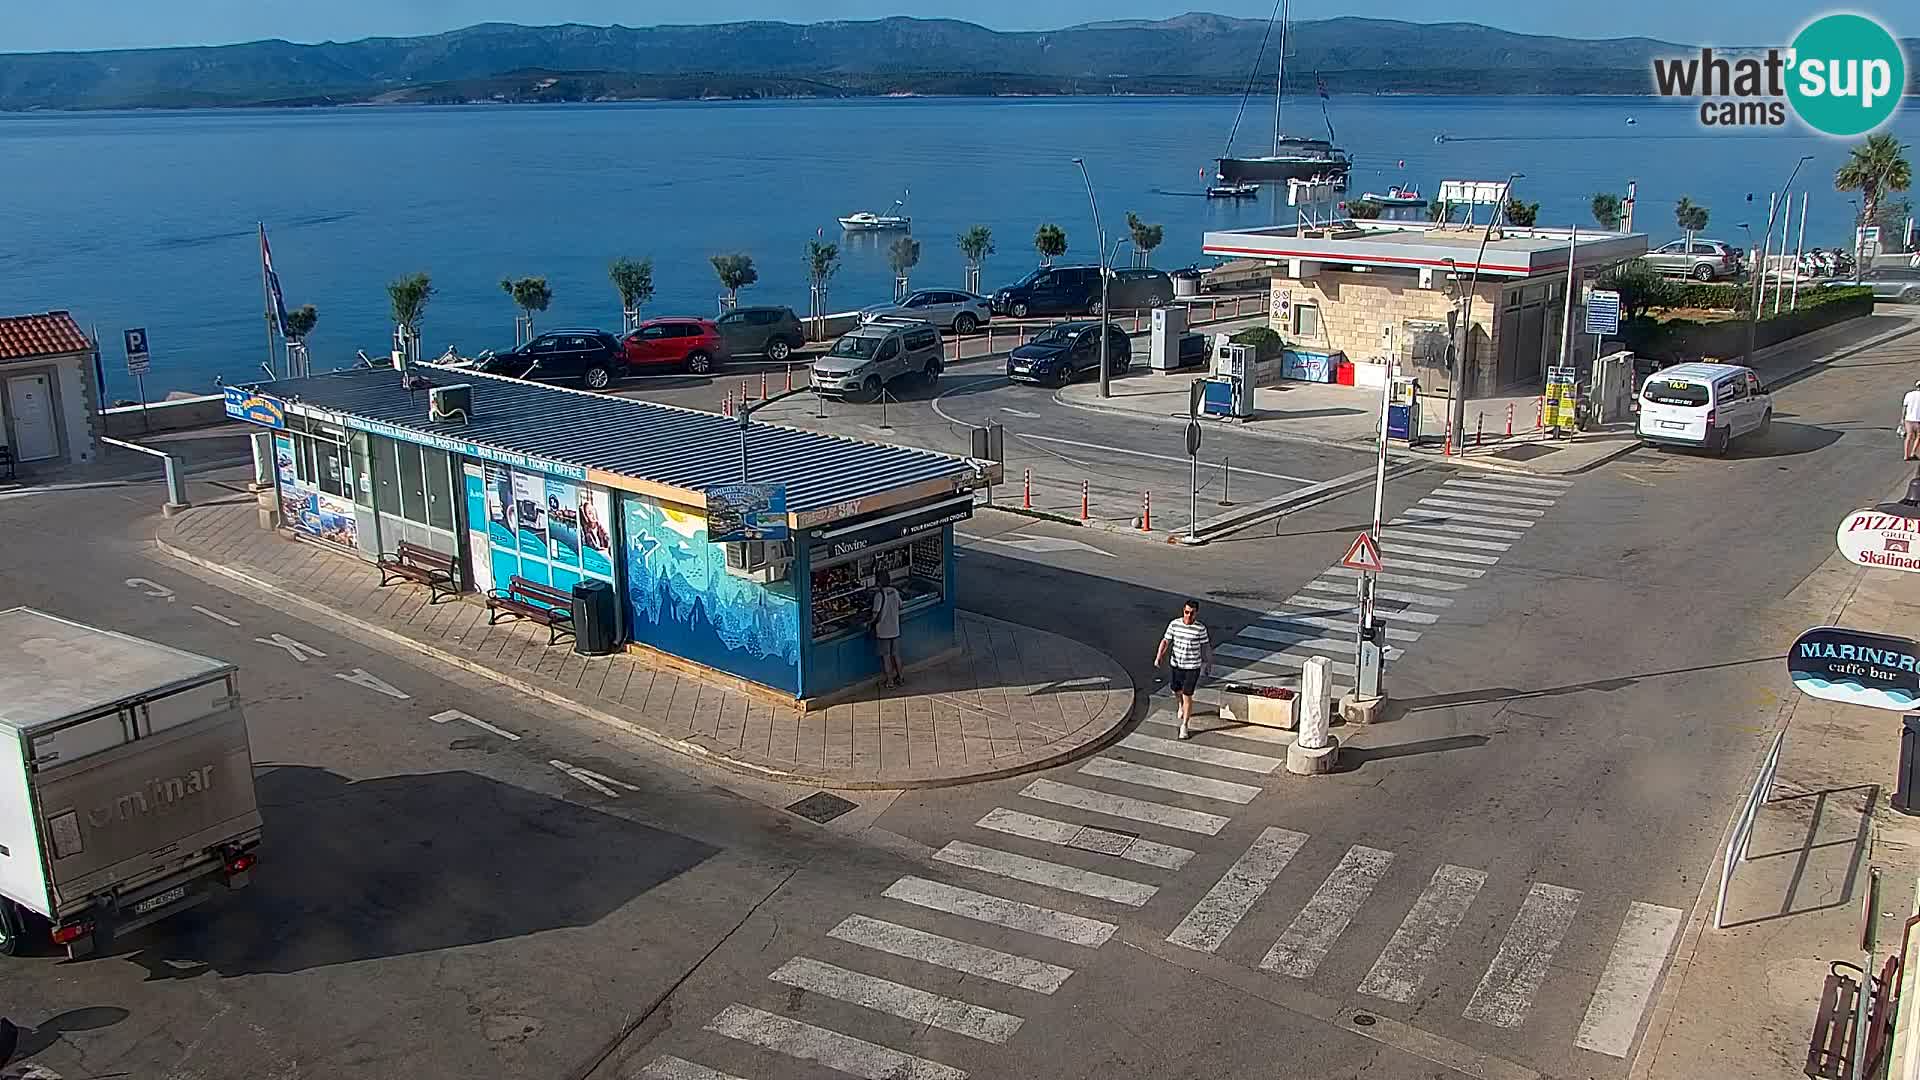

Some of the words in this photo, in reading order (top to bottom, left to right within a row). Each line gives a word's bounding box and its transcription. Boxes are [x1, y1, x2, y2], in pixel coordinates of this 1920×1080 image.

[130, 332, 141, 350] P
[1669, 381, 1688, 389] TAXI
[436, 436, 467, 451] POSTAJA
[477, 445, 492, 458] BUS
[493, 448, 526, 465] STATION
[528, 456, 554, 473] TICKET
[554, 462, 582, 477] OFFICE
[1881, 530, 1917, 541] GRILL
[1829, 662, 1866, 676] caffe
[1870, 664, 1897, 681] bar
[119, 764, 214, 820] mlinar
